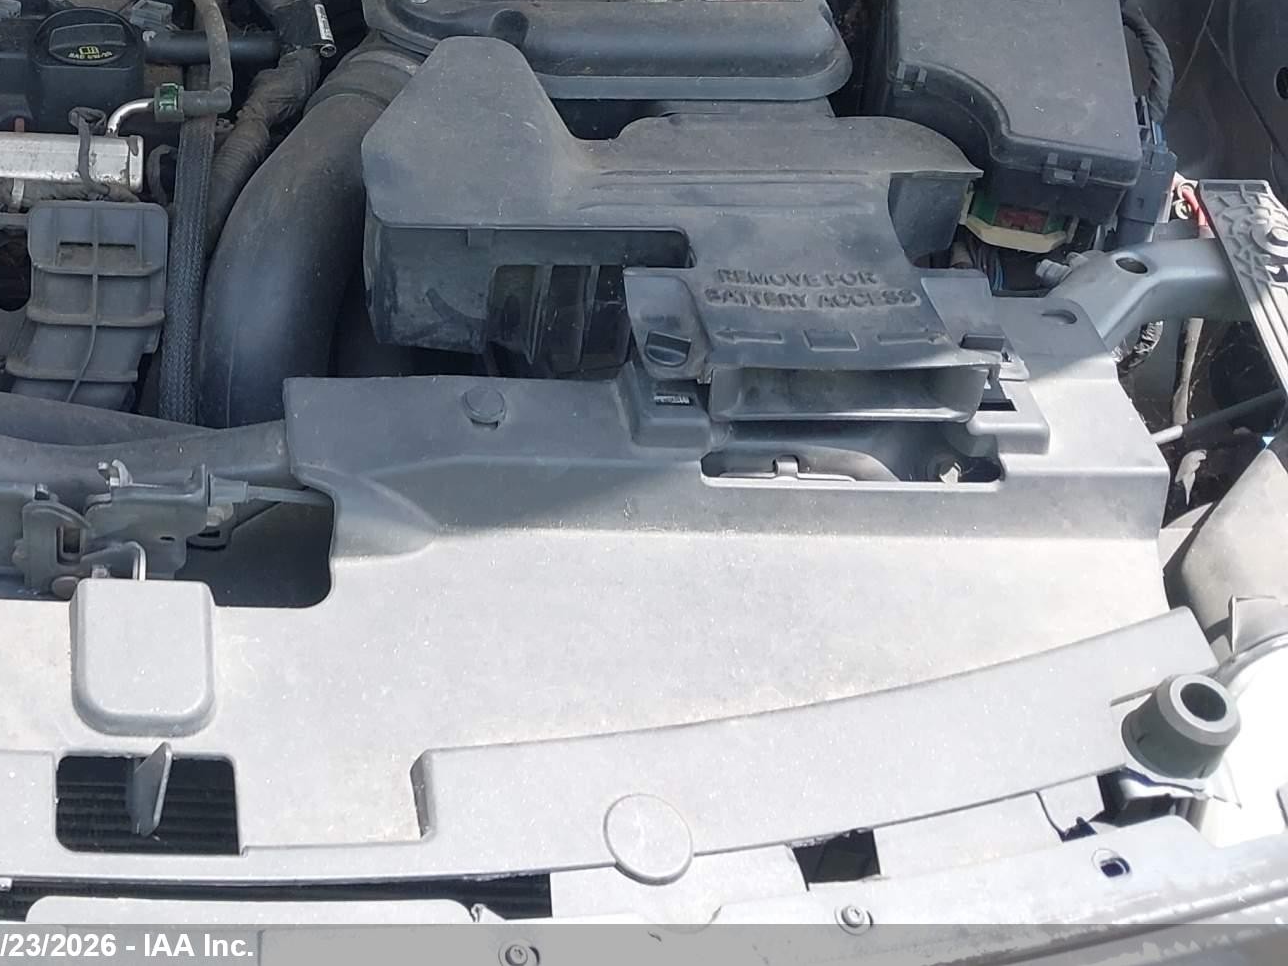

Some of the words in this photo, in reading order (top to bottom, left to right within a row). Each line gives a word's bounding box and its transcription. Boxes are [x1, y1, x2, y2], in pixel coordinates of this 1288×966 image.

[716, 268, 817, 286] REMOVE
[822, 270, 880, 286] FOR
[704, 287, 809, 308] BATTERY
[817, 289, 918, 309] ACCESS
